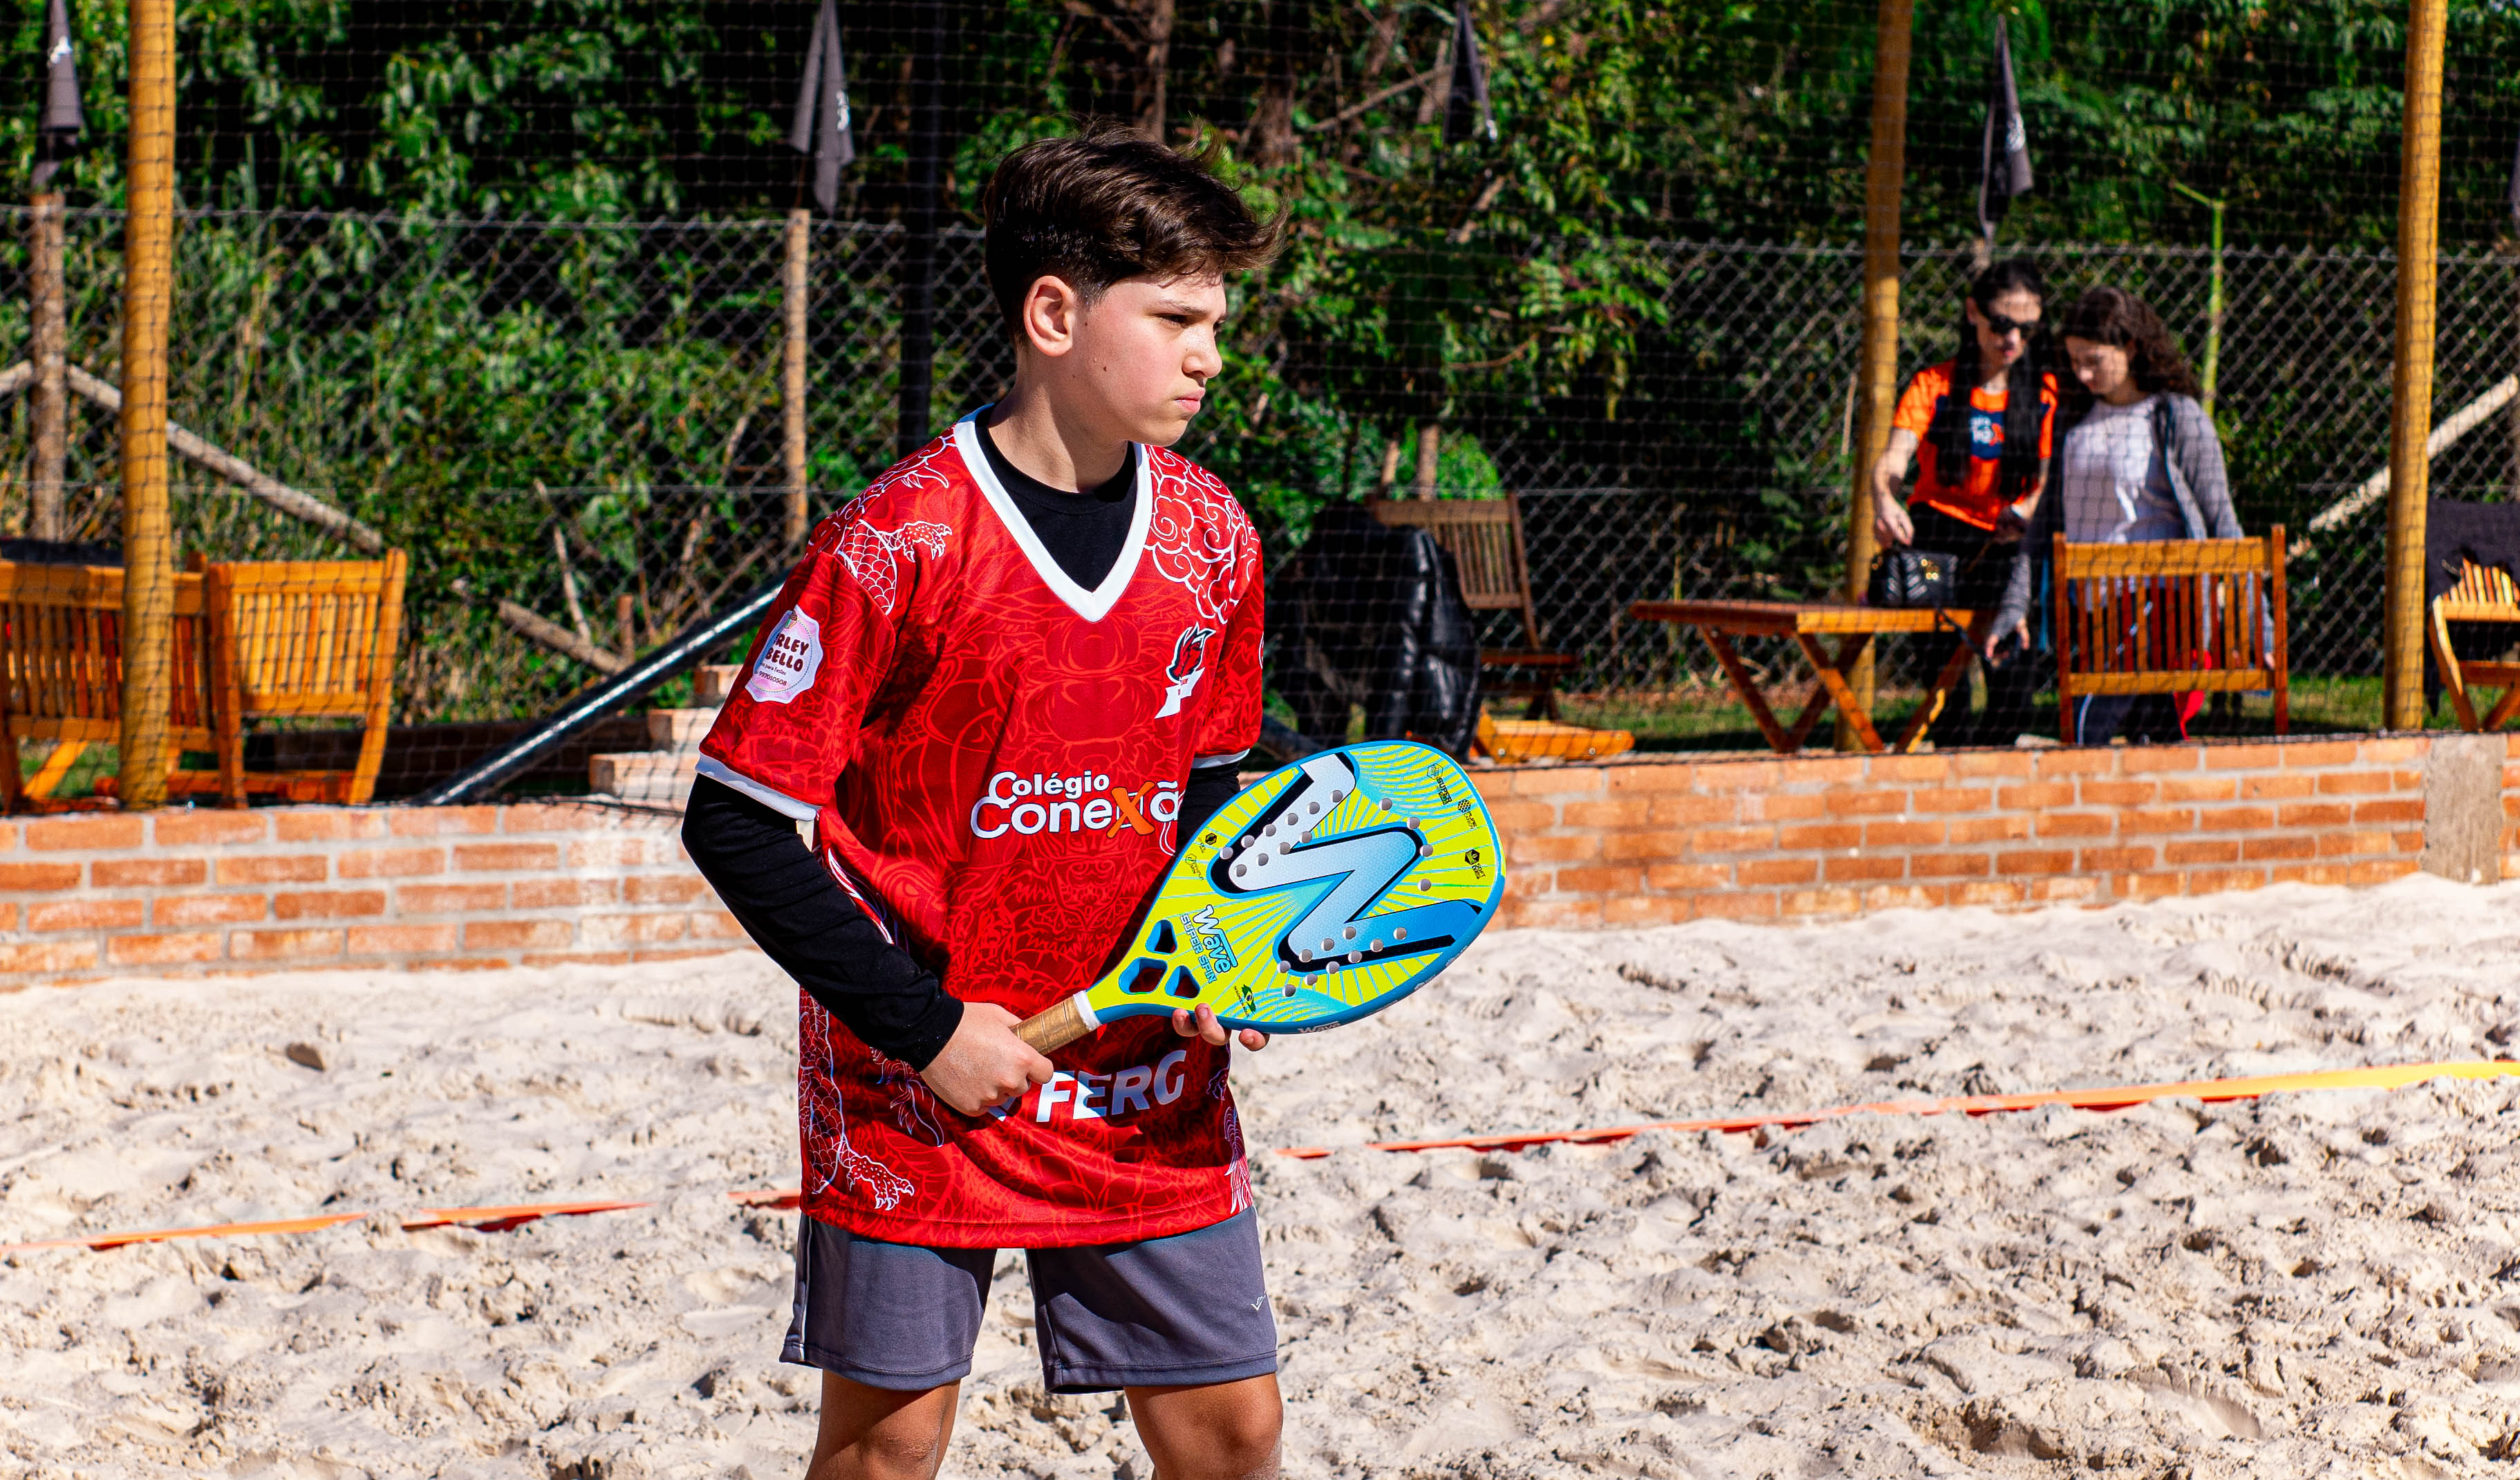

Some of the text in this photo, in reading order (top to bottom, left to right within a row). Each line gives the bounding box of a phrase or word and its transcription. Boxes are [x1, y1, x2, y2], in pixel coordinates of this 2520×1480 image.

[765, 646, 803, 673] BELLO
[970, 780, 1179, 839] ConeXã
[988, 769, 1110, 804] Colégio
[1436, 777, 1453, 803] SUPER
[1179, 914, 1217, 984] SUPER SPIN
[1193, 904, 1238, 973] Wave
[1036, 1050, 1187, 1123] FERG
